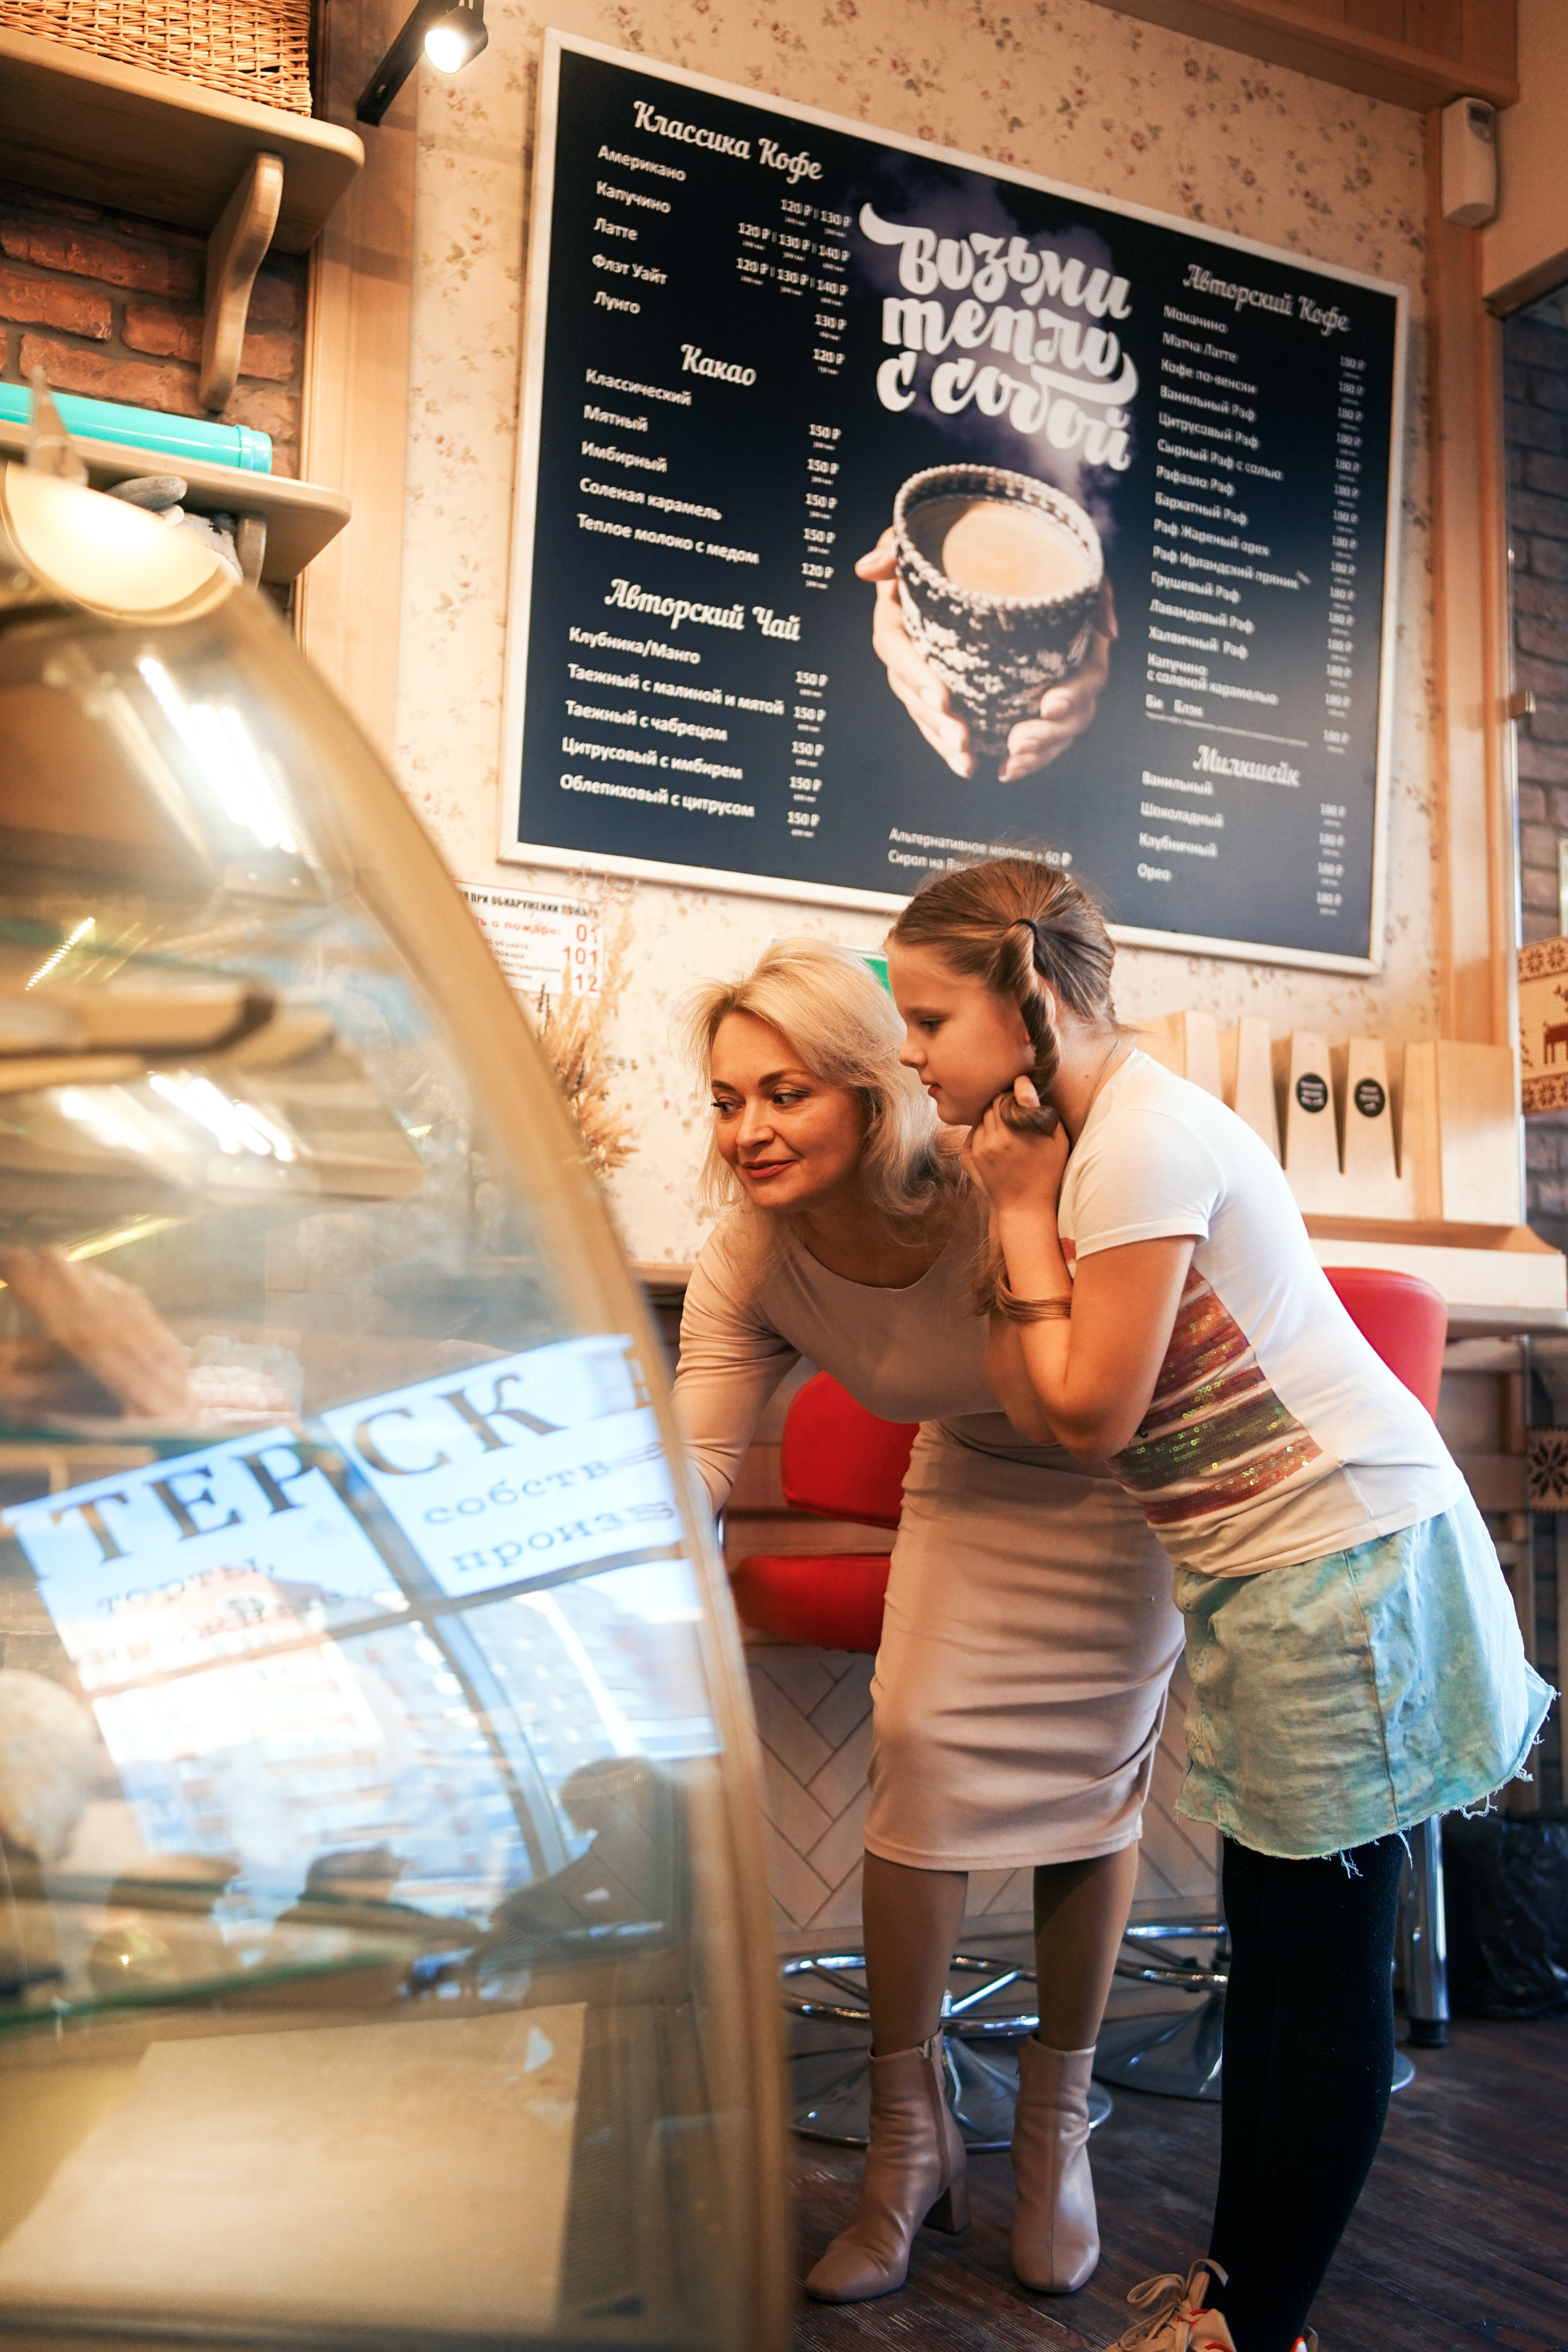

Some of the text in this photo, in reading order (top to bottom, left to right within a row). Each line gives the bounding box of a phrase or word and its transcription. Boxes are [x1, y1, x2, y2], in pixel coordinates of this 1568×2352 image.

[632, 99, 823, 184] Классика Кофе
[598, 145, 686, 181] Американо
[597, 181, 671, 213] Капучино
[594, 217, 638, 240] Латте
[592, 254, 668, 284] Флэт Уайт
[594, 292, 640, 314] Лунго
[1183, 263, 1349, 336] Авторский Кофе
[1164, 305, 1227, 333] Мокачино
[681, 344, 756, 385] Какао
[1163, 332, 1238, 363] Матча Латте
[585, 368, 692, 408] Классический
[1161, 358, 1256, 394] Кофе по-венски
[584, 405, 647, 432] Мятный
[1159, 383, 1256, 421] Ванильный Раф
[1158, 410, 1259, 449] Цитрусовый Раф
[582, 441, 667, 472] Имбирный
[1158, 439, 1282, 480] Сырный Раф с солью
[580, 478, 722, 520] Соленая карамель
[1156, 466, 1235, 496] Рафаэло Раф
[1155, 492, 1248, 526] Бархатный Раф
[577, 513, 759, 564] Теплое молоко с медом
[1154, 519, 1269, 556] Раф Жареный орех
[1153, 546, 1178, 564] Раф
[1180, 549, 1256, 579] Ирландский
[1256, 571, 1302, 590] пряник
[1152, 571, 1240, 604] Грушевый Раф
[605, 579, 801, 641] Авторский Чай
[1149, 599, 1254, 635] Лавандовый Раф
[568, 625, 700, 666] Клубника/Манго
[1148, 625, 1248, 660] Халвичный Раф
[1147, 652, 1208, 678] Капучино
[568, 663, 784, 715] Таежный с малиной и мятой
[1145, 694, 1204, 717] Би Блэк
[1156, 669, 1210, 692] соленой
[1208, 682, 1279, 706] карамелью
[565, 700, 727, 741] Таежный с чабрецом
[562, 737, 742, 779] Цитрусовый с имбирем
[1191, 743, 1302, 789] Милкшейк
[560, 774, 755, 817] Облепиховый с цитрусом
[1142, 769, 1216, 796] Ванильный
[1141, 802, 1224, 828] Шоколадный
[888, 826, 988, 854] Альтернативное
[1139, 832, 1218, 858] Клубничный
[888, 849, 927, 867] Сироп
[929, 859, 946, 869] на
[1137, 863, 1172, 881] Орео
[563, 946, 597, 965] 101
